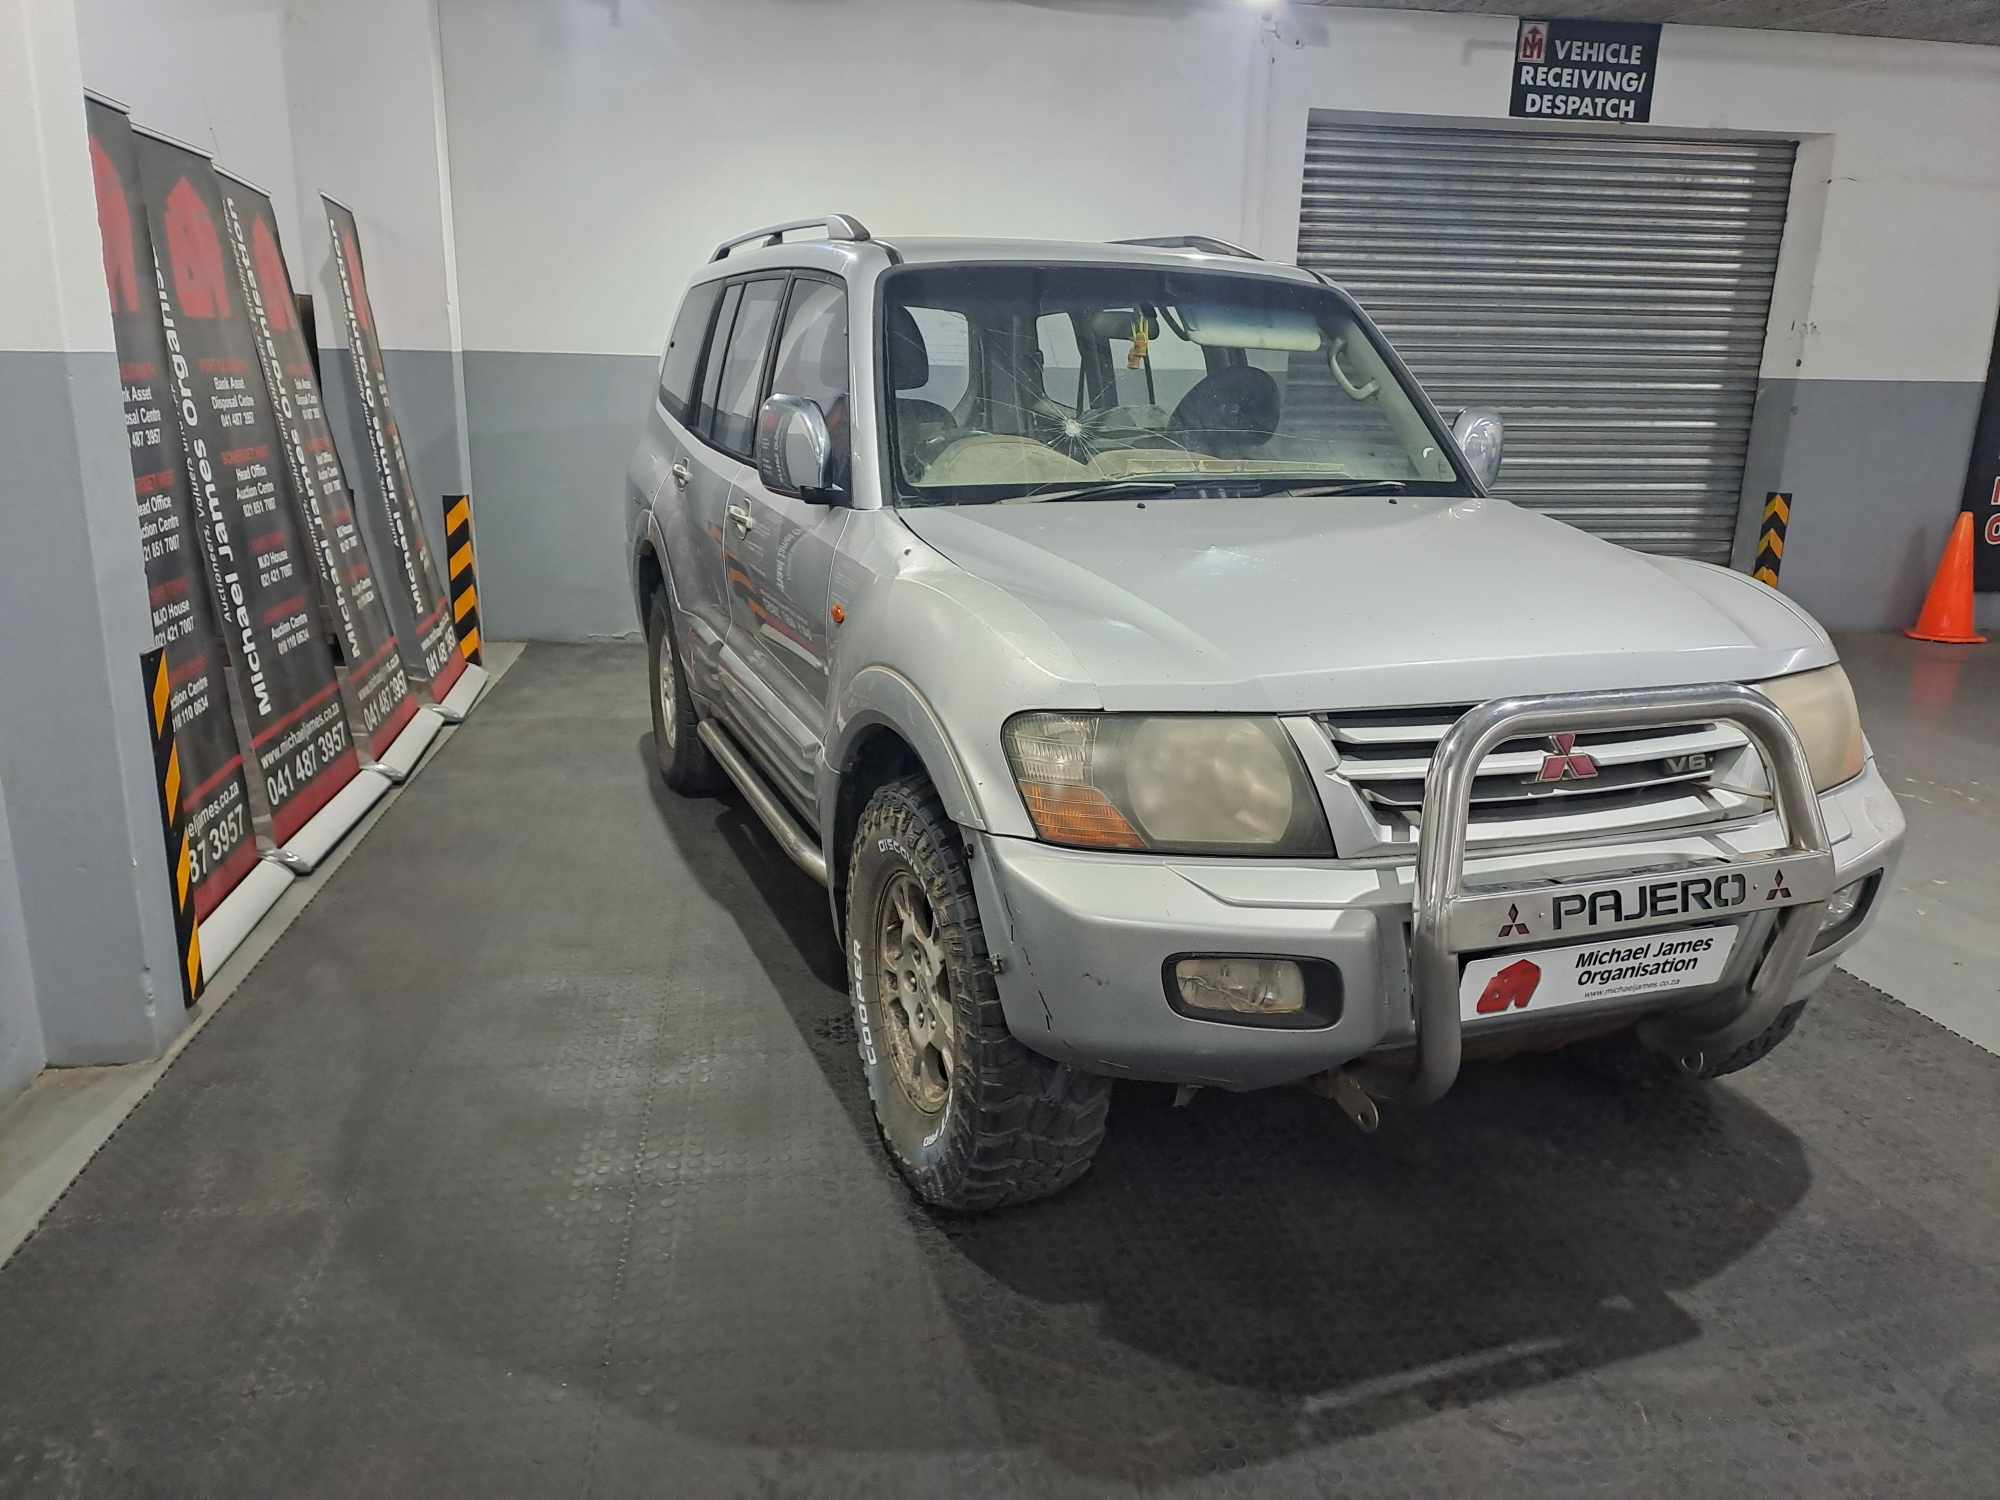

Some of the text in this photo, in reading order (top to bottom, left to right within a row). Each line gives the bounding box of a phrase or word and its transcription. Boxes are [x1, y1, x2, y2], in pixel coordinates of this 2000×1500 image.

[1555, 39, 1643, 65] VEHICLE
[1520, 65, 1647, 93] RECEIVING/
[1525, 93, 1636, 119] DESPATCH
[372, 416, 398, 504] James
[291, 428, 326, 533] James
[137, 494, 172, 516] ead Office
[193, 438, 234, 562] James
[158, 514, 179, 533] Centre
[152, 541, 164, 559] 851
[320, 538, 361, 659] Michael
[153, 600, 190, 628] MJO House
[167, 623, 180, 642] 421
[224, 572, 272, 716] Michael
[187, 676, 208, 702] Centre
[266, 720, 347, 807] 041 487 3957
[1666, 753, 1707, 773] V6
[189, 803, 245, 885] 87 3957
[1552, 873, 1747, 930] PAJERO
[1575, 937, 1714, 968] Michael James
[1577, 957, 1699, 985] Organisation
[853, 939, 877, 1065] COOPER
